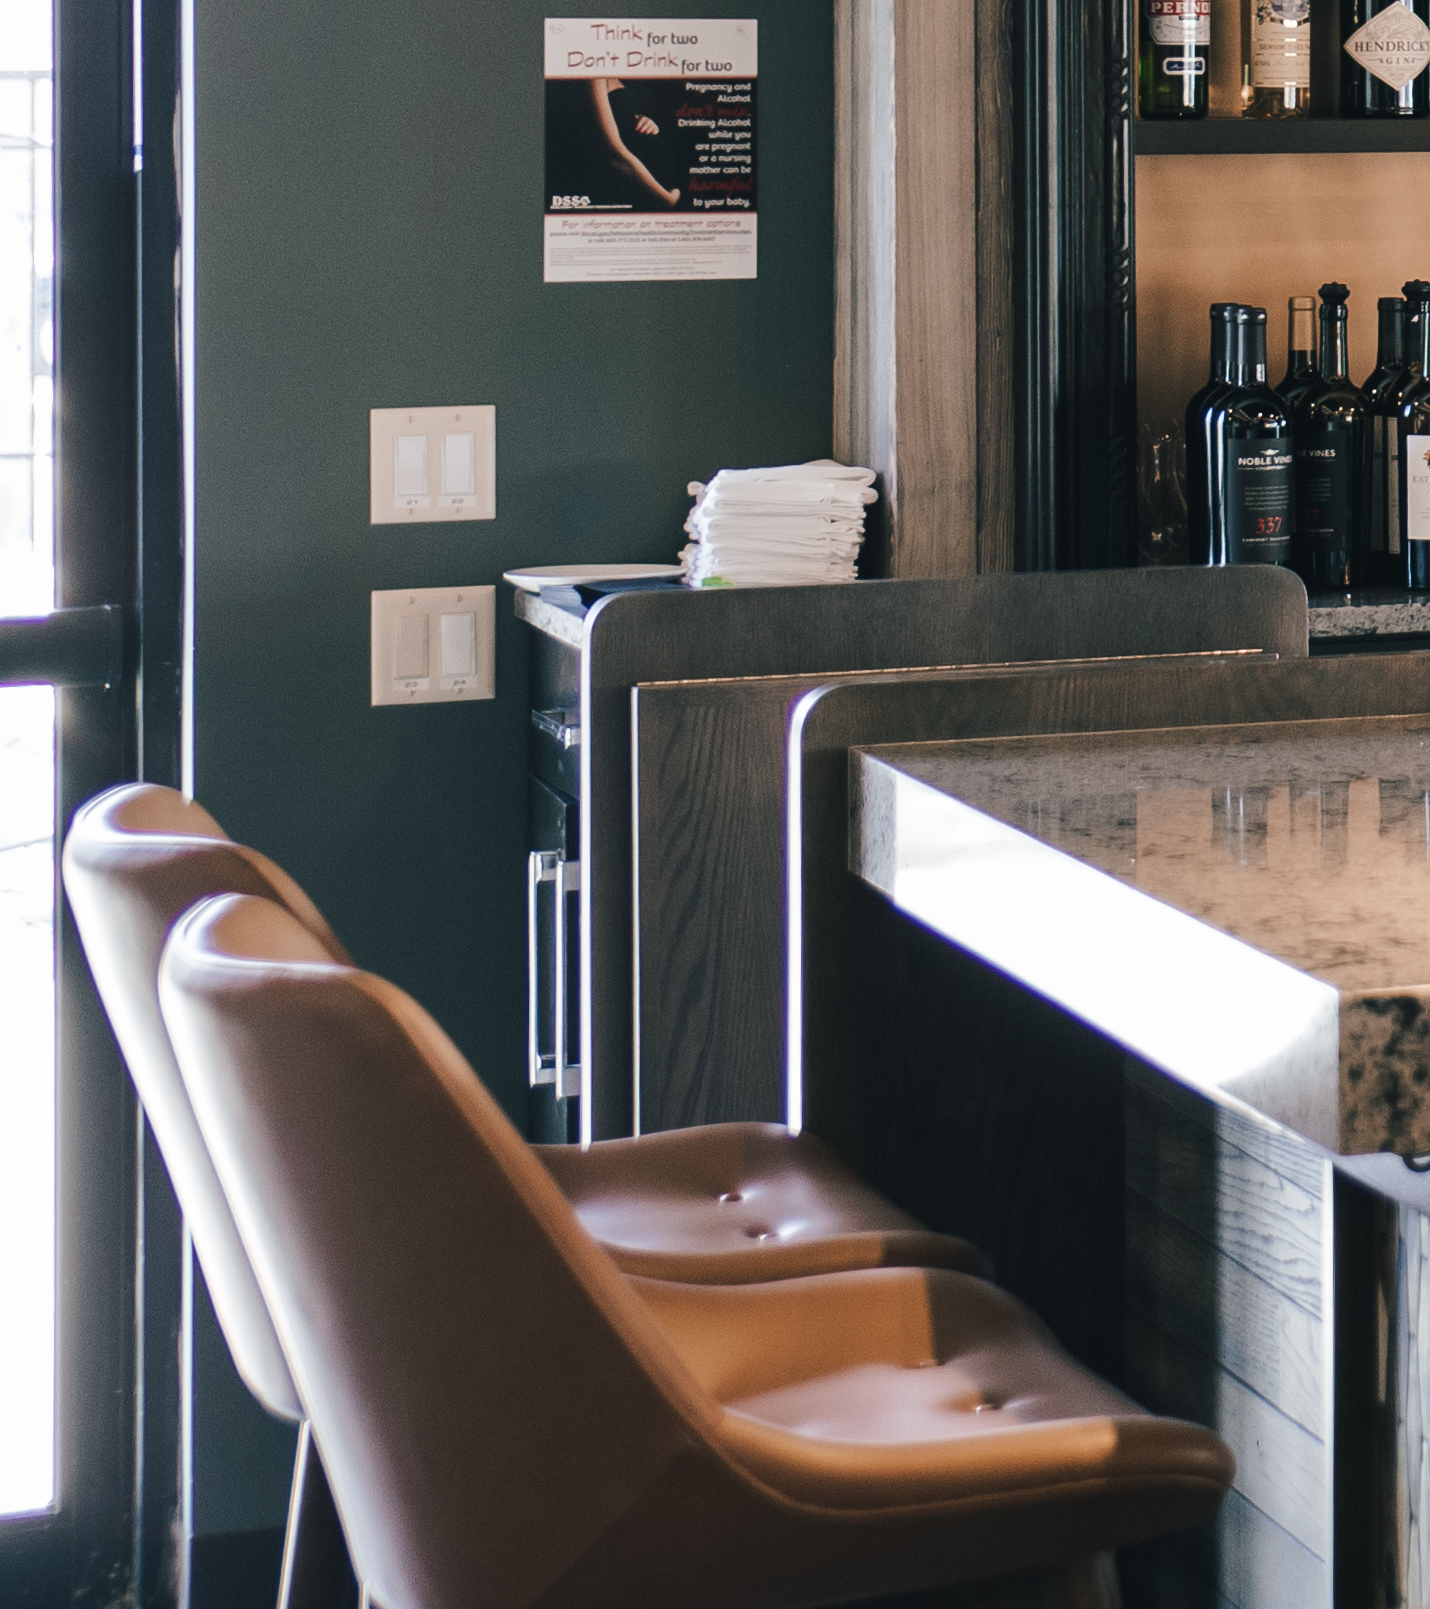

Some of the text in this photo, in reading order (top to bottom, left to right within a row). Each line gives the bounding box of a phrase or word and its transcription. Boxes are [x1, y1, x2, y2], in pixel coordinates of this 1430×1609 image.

[591, 24, 698, 47] Think for two
[1354, 41, 1430, 53] HENDRICK'S
[567, 51, 733, 75] Don't Drink for two
[685, 82, 751, 93] Pregnancy and
[717, 94, 751, 103] Alcohol
[678, 118, 751, 128] Drinking Alcohol
[708, 131, 751, 140] while you
[711, 143, 751, 152] pregnant
[719, 154, 751, 164] nursing
[689, 166, 721, 174] mother
[741, 166, 751, 174] be
[704, 199, 725, 208] your
[1238, 457, 1272, 466] NOBLE
[1256, 516, 1283, 534] 337
